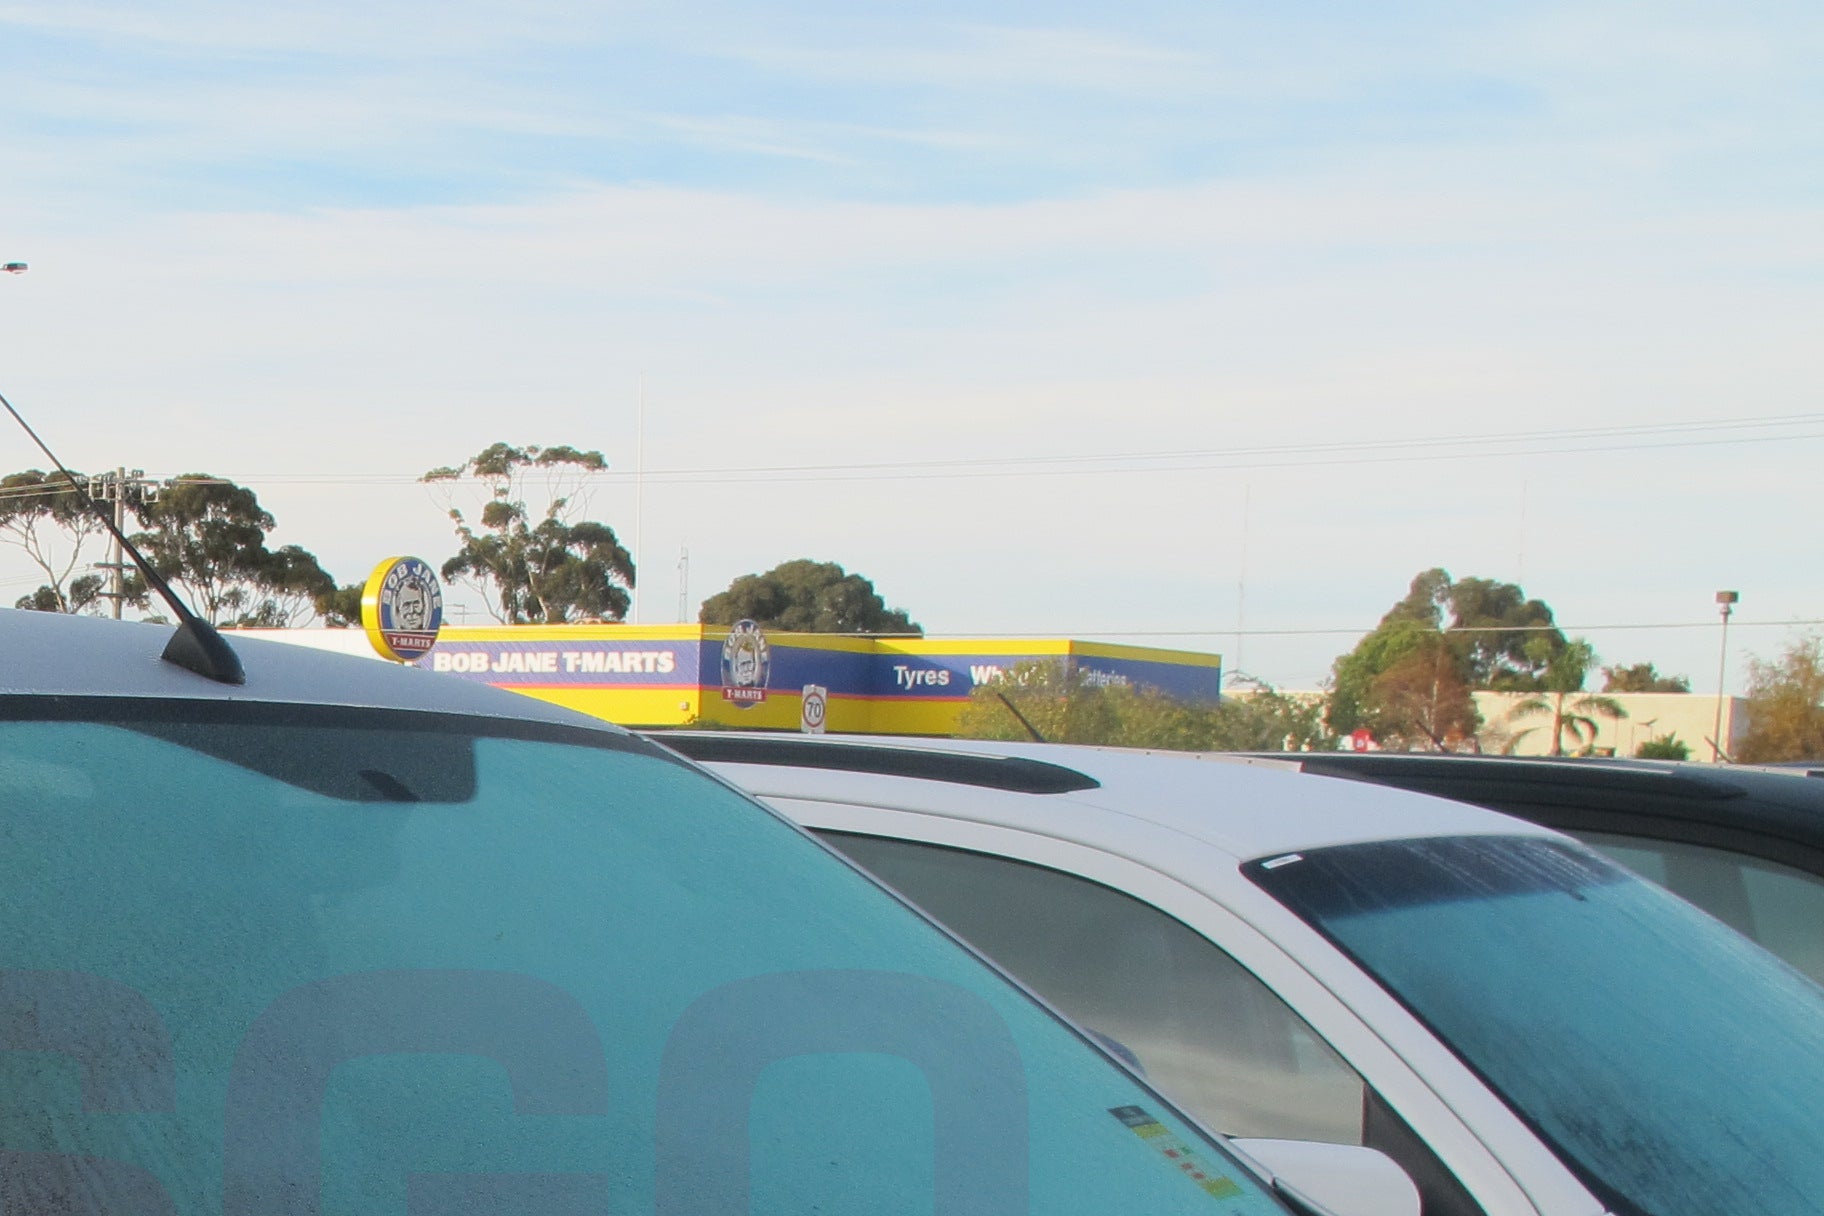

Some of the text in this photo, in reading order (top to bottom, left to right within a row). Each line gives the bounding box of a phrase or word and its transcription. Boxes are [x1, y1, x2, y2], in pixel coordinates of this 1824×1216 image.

[382, 563, 441, 608] BOB JANE
[392, 636, 431, 648] T-MARTS
[433, 651, 676, 673] BOB JANE T-MARTS
[893, 665, 950, 690] Tyres
[807, 702, 822, 718] 70
